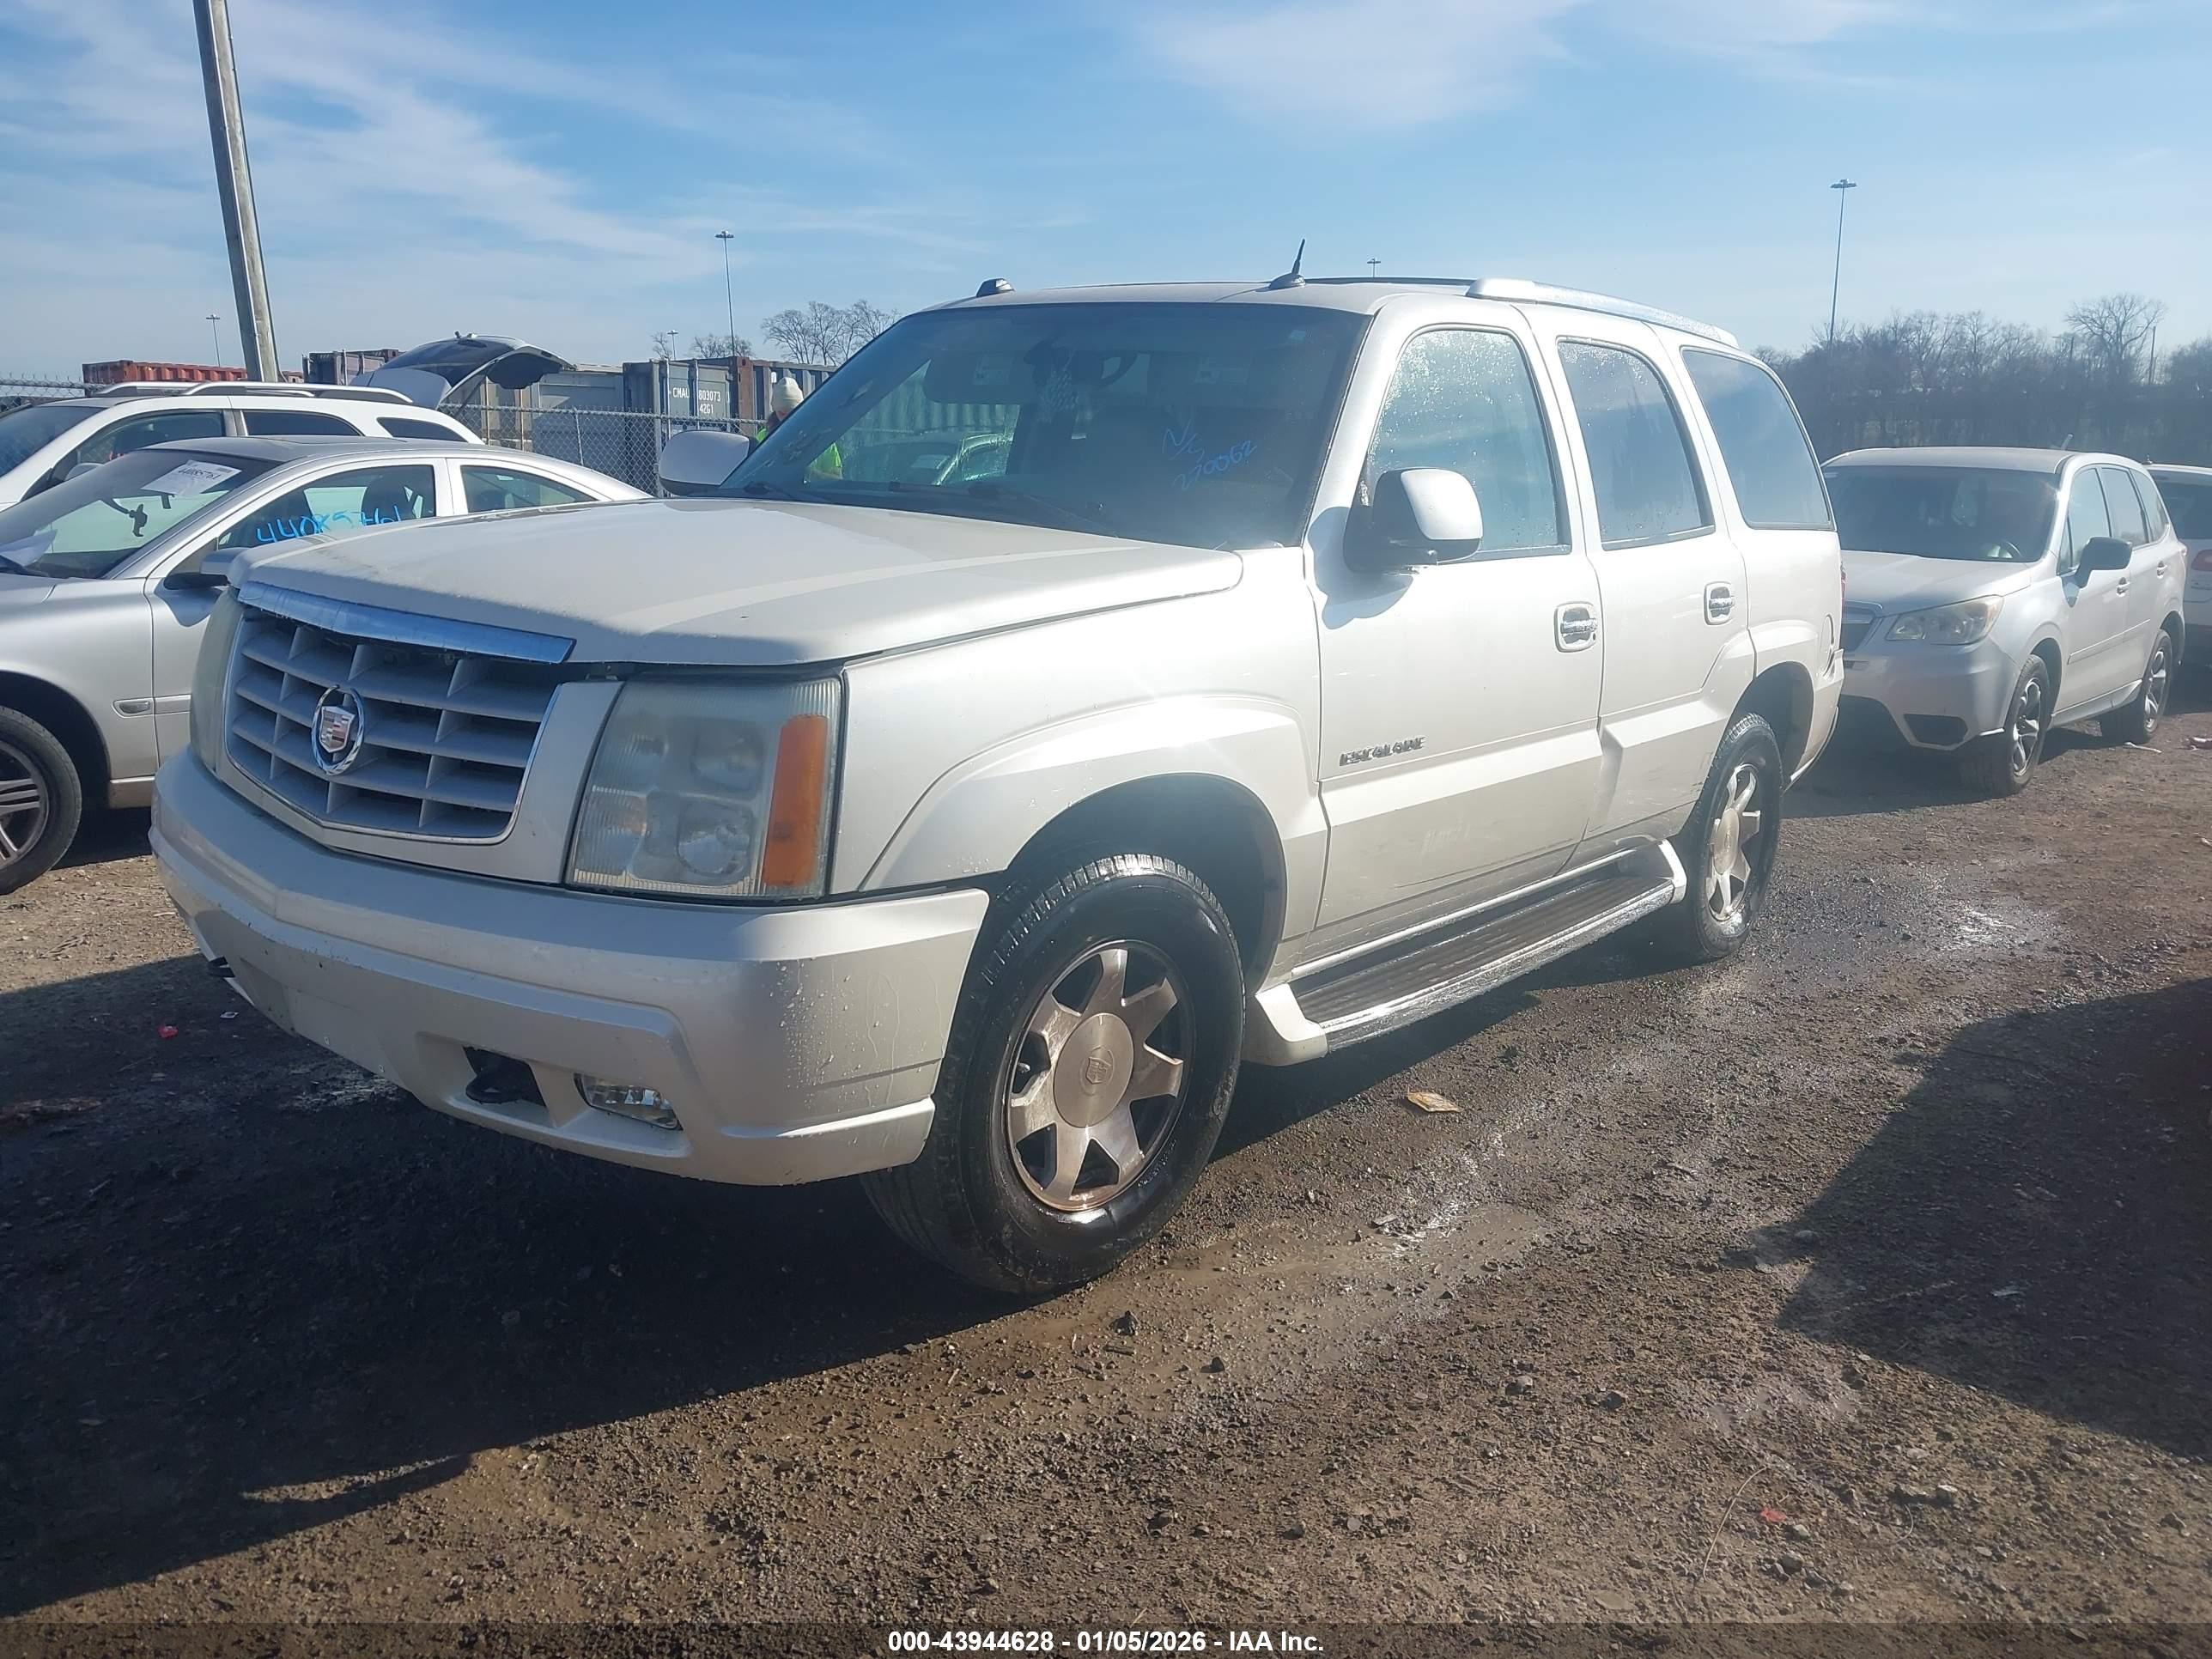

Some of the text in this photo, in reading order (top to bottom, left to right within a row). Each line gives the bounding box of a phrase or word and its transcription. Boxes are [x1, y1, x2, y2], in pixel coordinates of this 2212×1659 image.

[672, 387, 721, 402] CMAU 803073
[699, 404, 714, 414] 42G1
[1339, 735, 1426, 767] ESCALADE
